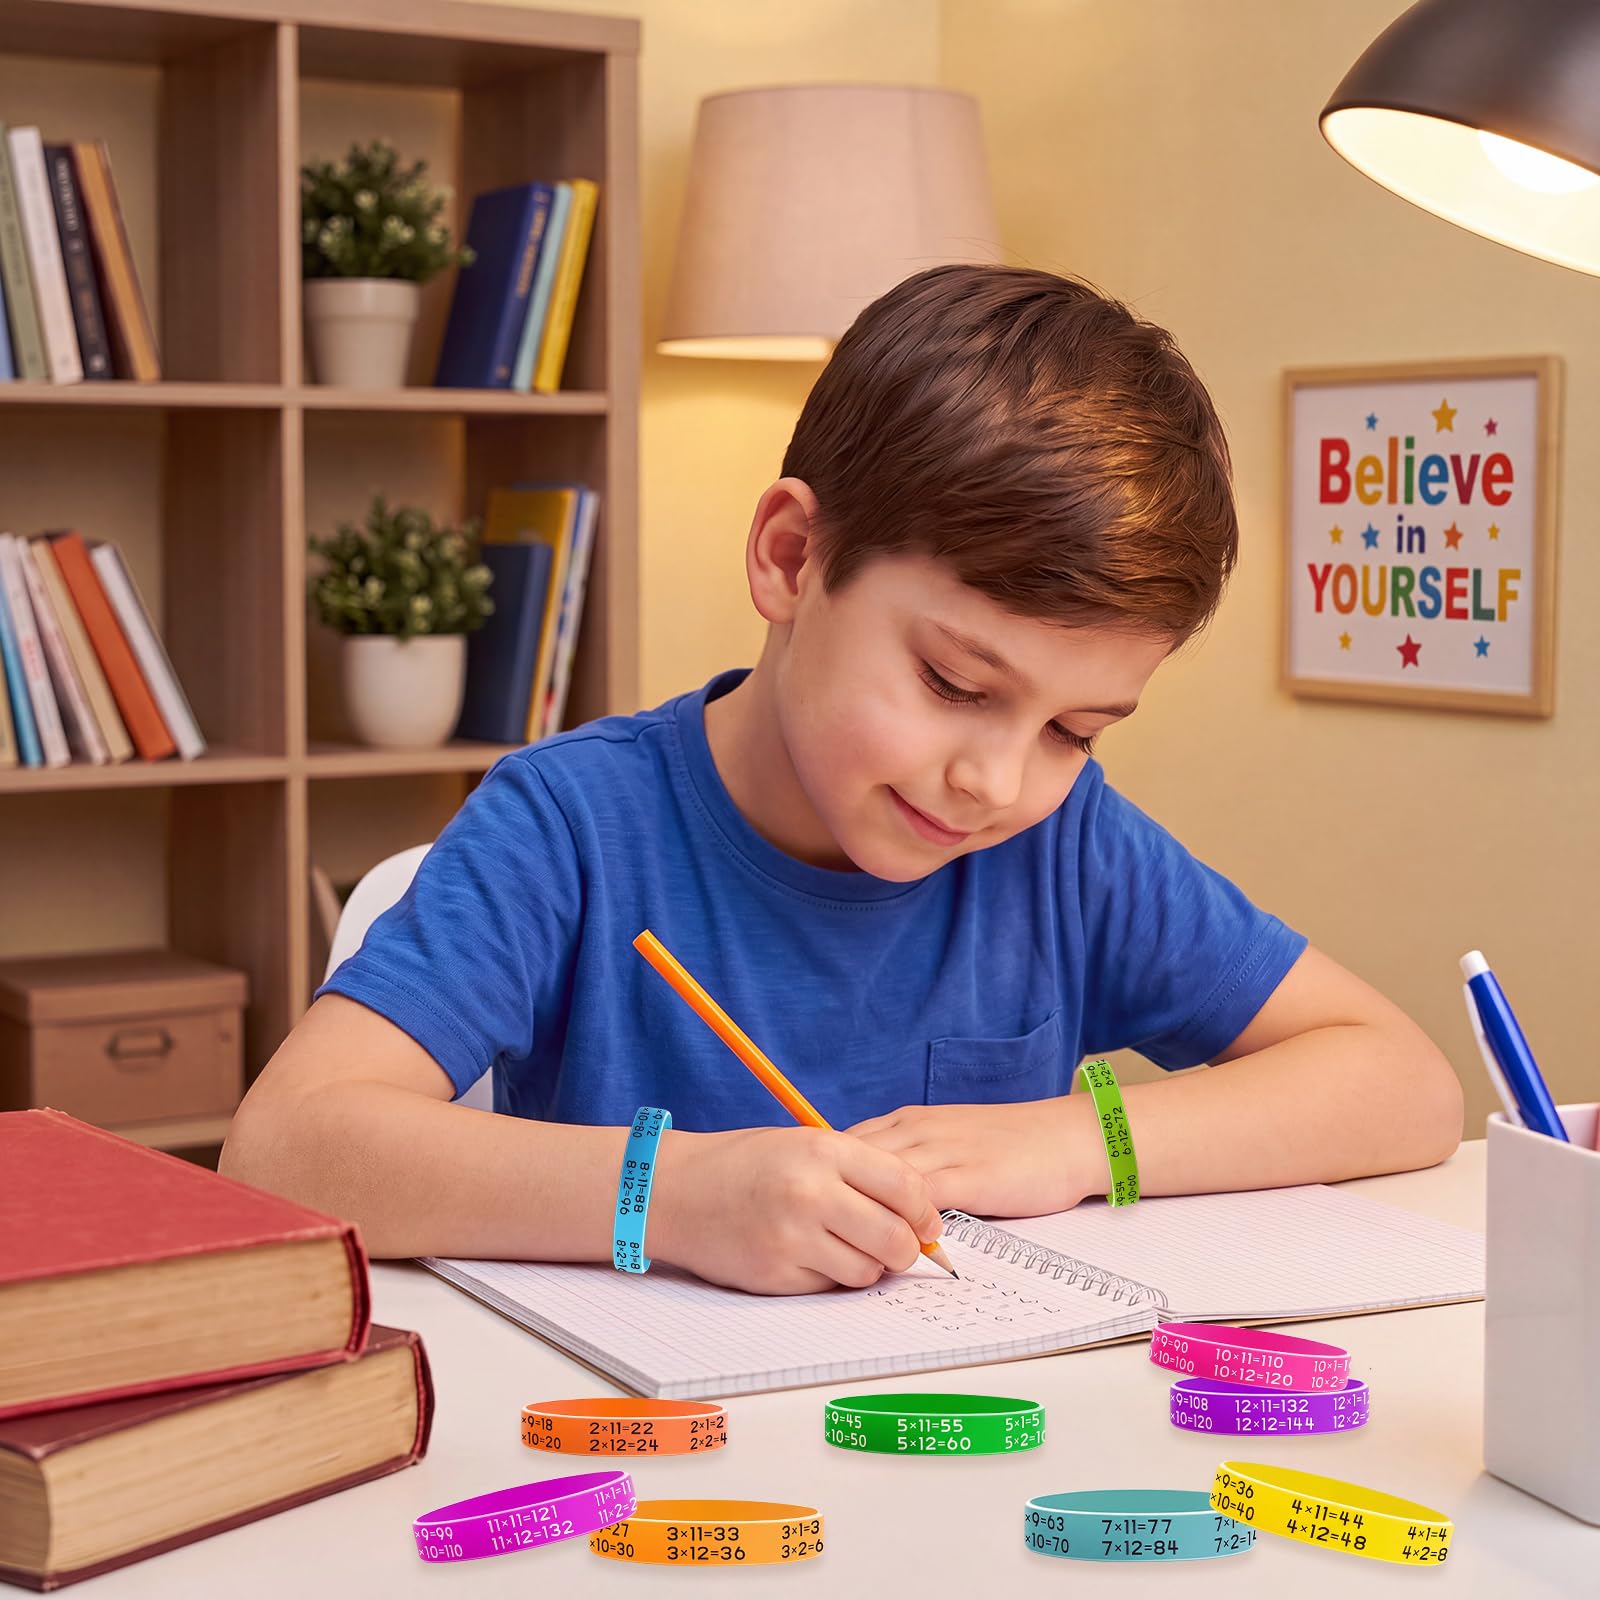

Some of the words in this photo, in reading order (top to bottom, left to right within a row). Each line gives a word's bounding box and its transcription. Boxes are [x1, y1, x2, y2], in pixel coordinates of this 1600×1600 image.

[1319, 436, 1514, 506] Believe
[1397, 514, 1426, 553] in
[1307, 563, 1521, 622] YOURSELF
[1102, 1113, 1119, 1157] 6×11=66
[1113, 1106, 1131, 1155] 6×12=72
[620, 1160, 637, 1215] 8×12=96
[634, 1162, 650, 1213] 8×11=88
[1216, 1349, 1283, 1369] 10×11=110
[1214, 1364, 1293, 1386] 10×12=120
[1235, 1399, 1309, 1413] 12×11=132
[590, 1422, 654, 1435] 2×11=22
[690, 1416, 724, 1433] 2×1=2
[897, 1419, 963, 1433] 5×11=55
[1005, 1414, 1039, 1432] 5×1=5
[1236, 1417, 1314, 1431] 12×12=144
[590, 1439, 658, 1451] 2×12=24
[690, 1432, 727, 1450] 2×2=4
[897, 1437, 971, 1450] 5×12=60
[487, 1505, 558, 1534] 11×11=121
[594, 1480, 632, 1506] 11×1=11
[667, 1527, 739, 1541] 3×11=33
[781, 1520, 820, 1539] 3×1=3
[1102, 1520, 1172, 1535] 7×11=77
[1291, 1499, 1364, 1529] 4×11=44
[1408, 1526, 1447, 1542] 4×1=4
[491, 1520, 574, 1551] 11×12=132
[1287, 1520, 1367, 1550] 4×12=48
[1402, 1545, 1448, 1561] 4×2=8
[667, 1546, 746, 1561] 3×12=36
[781, 1539, 824, 1558] 3×2=6
[1102, 1540, 1178, 1556] 7×12=84
